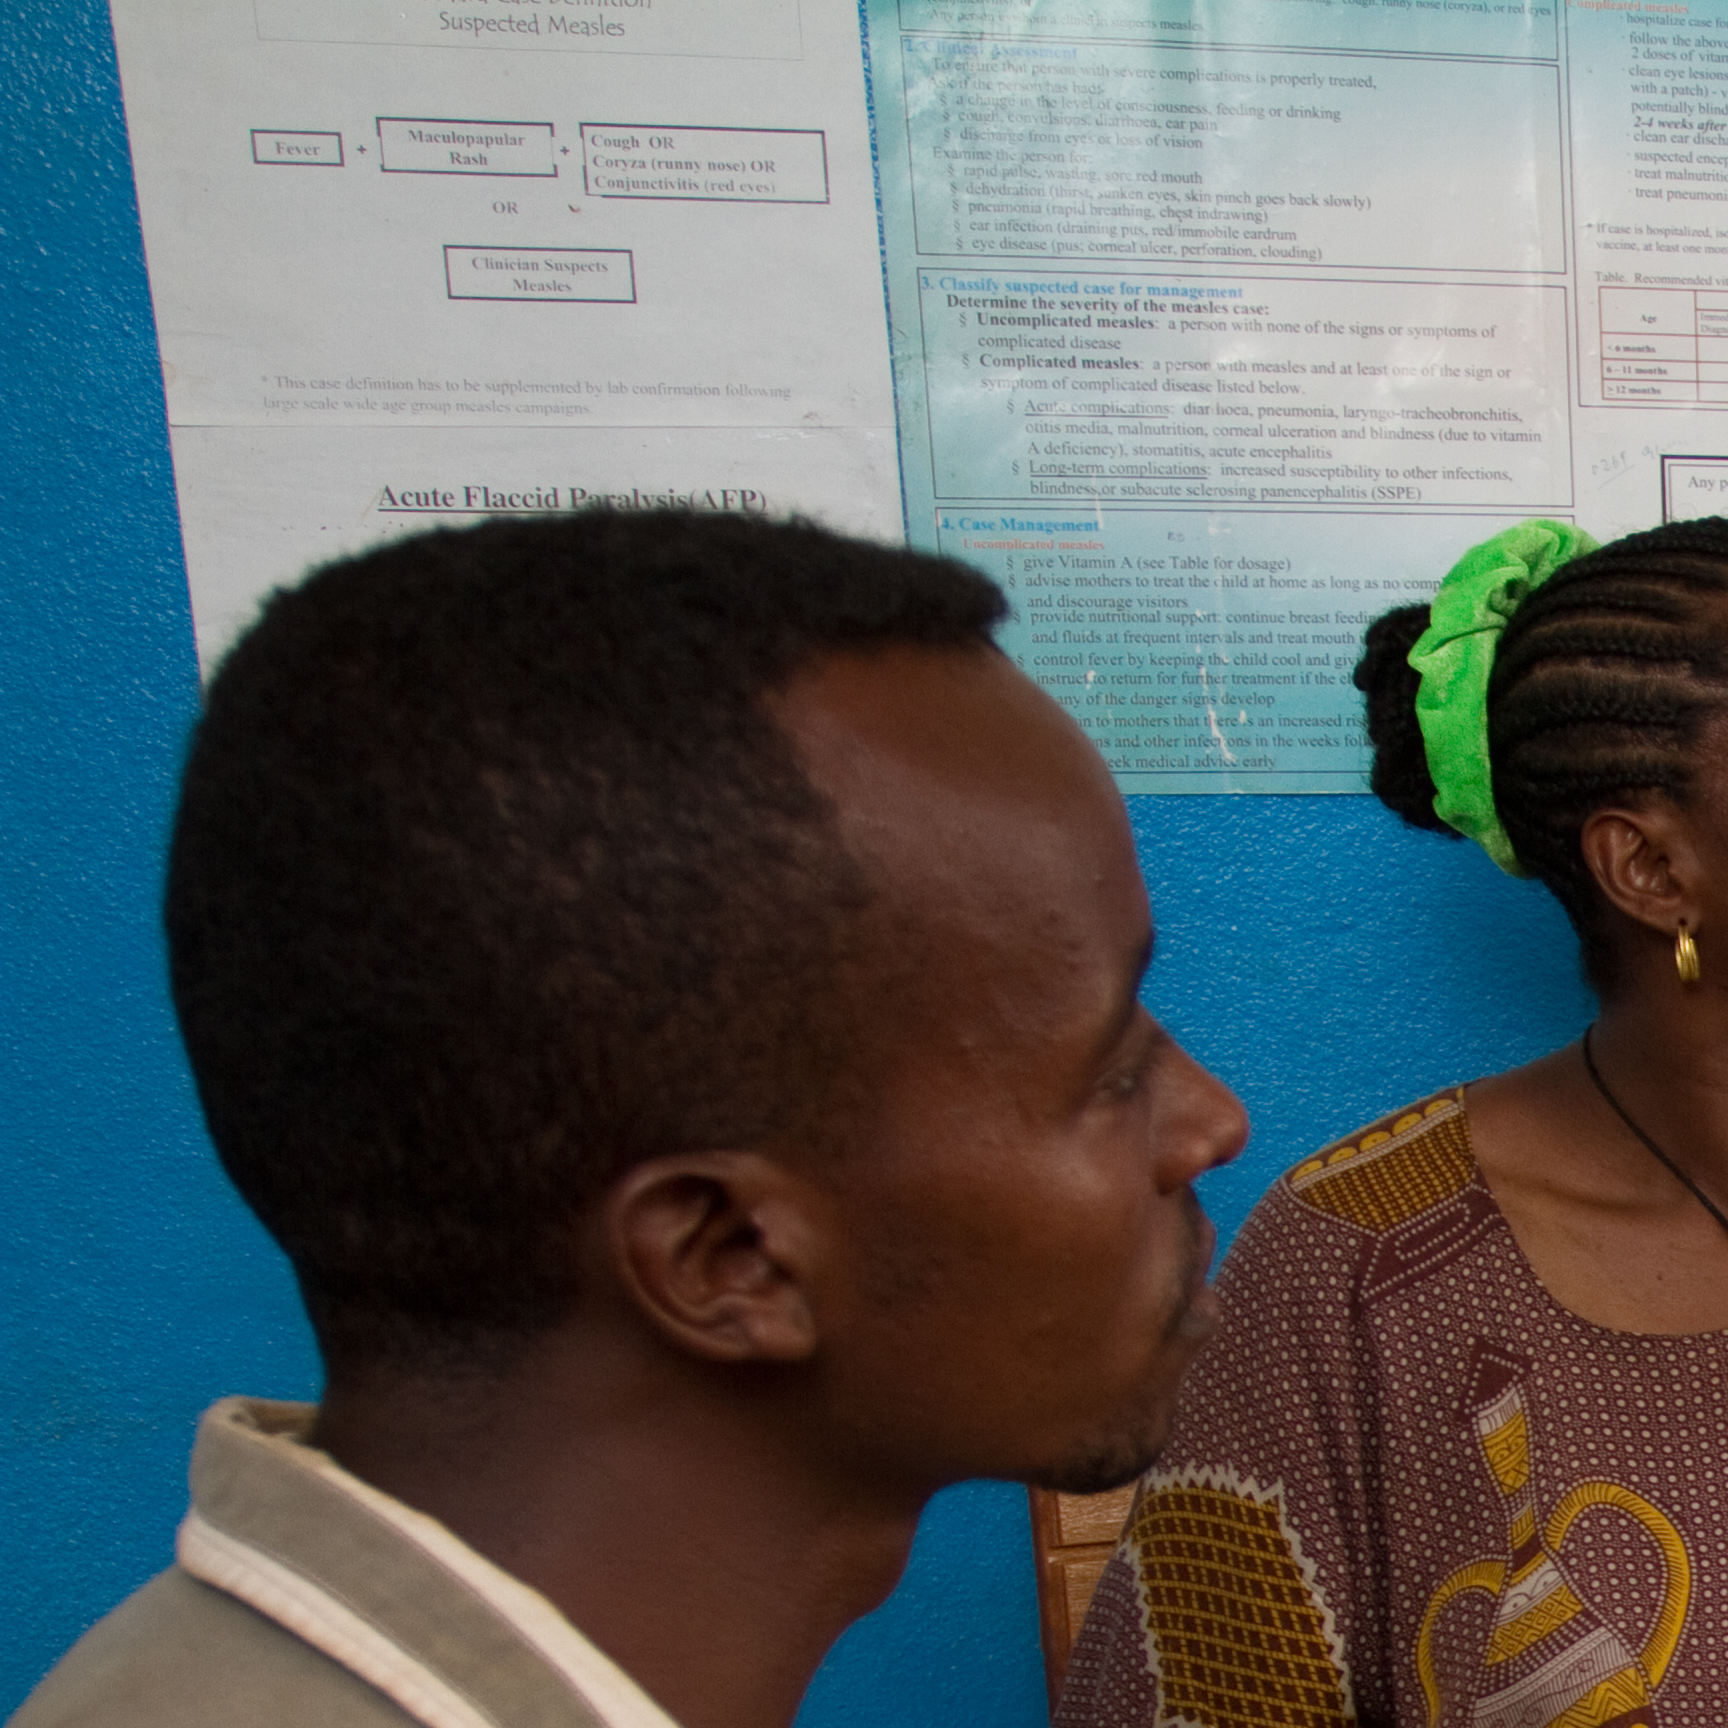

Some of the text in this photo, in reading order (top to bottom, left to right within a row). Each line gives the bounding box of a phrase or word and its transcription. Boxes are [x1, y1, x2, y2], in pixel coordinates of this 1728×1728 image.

[439, 11, 627, 38] Suspected Measles
[275, 141, 321, 156] Fever
[408, 128, 526, 150] Maculopapular
[591, 134, 676, 152] Cough OR
[450, 151, 488, 166] Rash
[593, 154, 776, 175] Coryza (runny nose) OR
[594, 175, 776, 196] Conjunctivitis (red eyes)
[492, 201, 519, 213] OR
[471, 256, 610, 276] Clinician Suspects
[512, 278, 573, 292] Measles
[921, 276, 1244, 302] 3. Classify suspected case for management
[1687, 474, 1716, 491] Any
[378, 486, 455, 507] Acute
[462, 487, 561, 508] Flaccid
